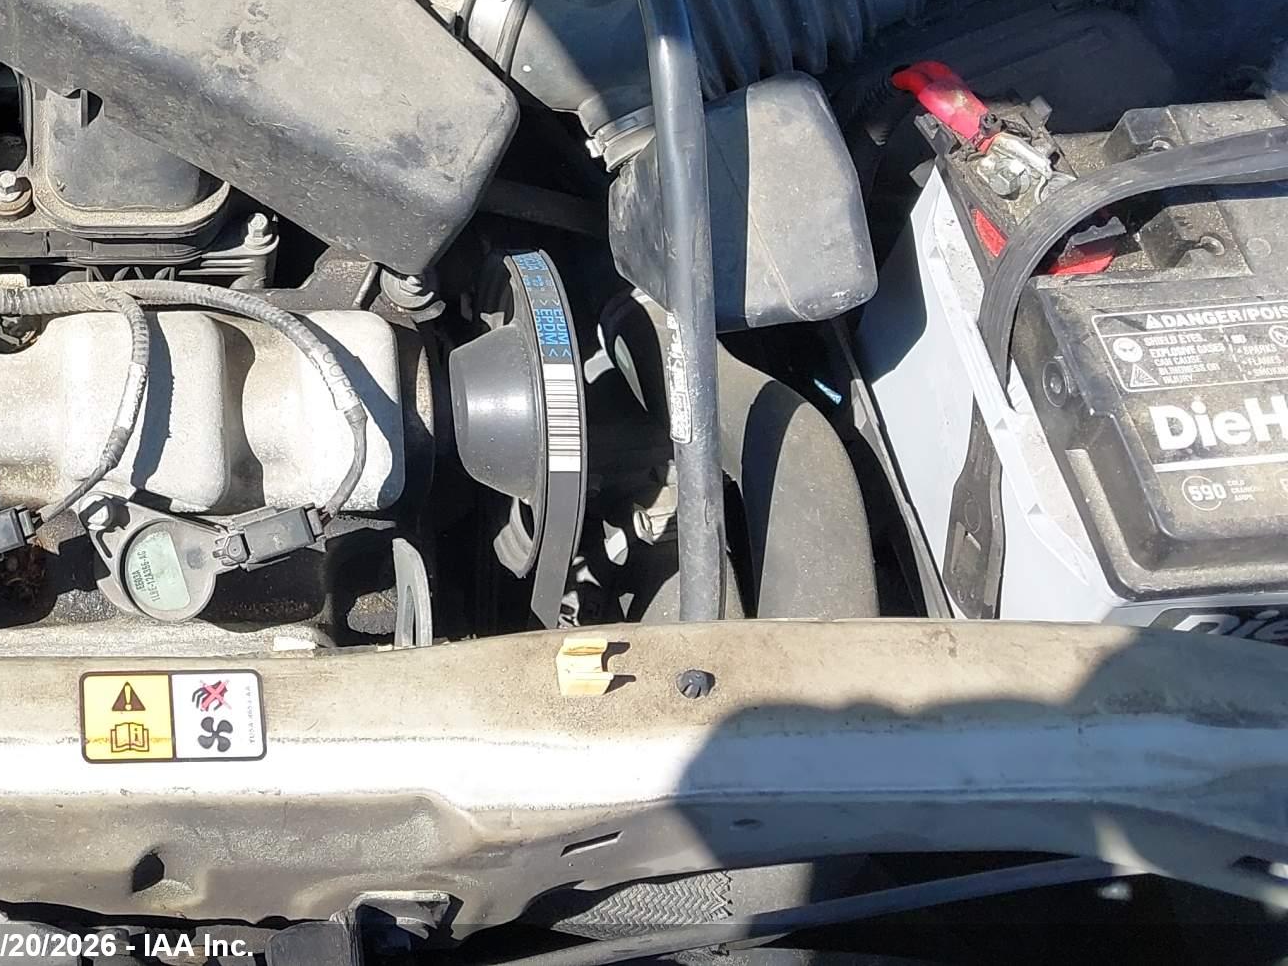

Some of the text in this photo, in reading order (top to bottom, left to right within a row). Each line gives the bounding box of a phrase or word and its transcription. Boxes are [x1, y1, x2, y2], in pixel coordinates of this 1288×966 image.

[540, 309, 559, 345] EPDM
[1149, 395, 1288, 450] DieH
[1187, 483, 1227, 502] 590
